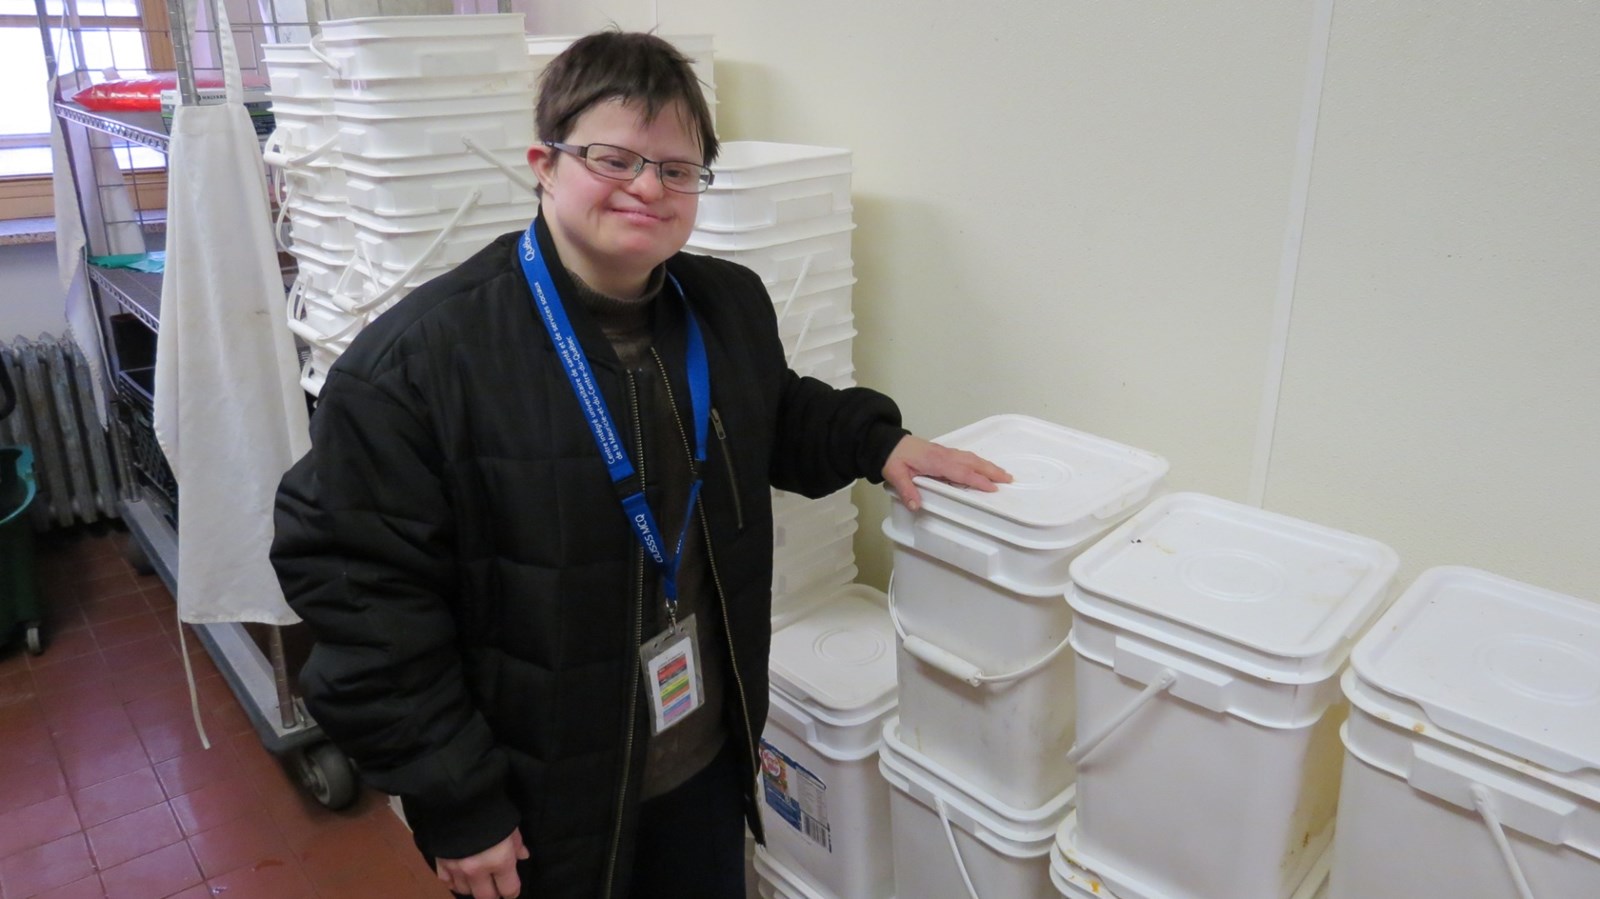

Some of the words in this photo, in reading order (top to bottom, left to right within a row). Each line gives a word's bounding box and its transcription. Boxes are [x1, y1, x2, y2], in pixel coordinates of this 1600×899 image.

[534, 281, 547, 305] sociaux
[544, 306, 558, 332] services
[555, 332, 563, 341] de
[558, 341, 566, 349] et
[562, 350, 574, 368] santé
[571, 368, 579, 377] de
[566, 336, 615, 444] Mauricie-et-du-Centre-du-Québec
[575, 378, 597, 418] universitaire
[592, 419, 606, 443] intégré
[603, 442, 615, 464] Centre
[615, 451, 623, 460] de
[635, 513, 651, 535] MCQ
[644, 534, 663, 563] CIUSSS
